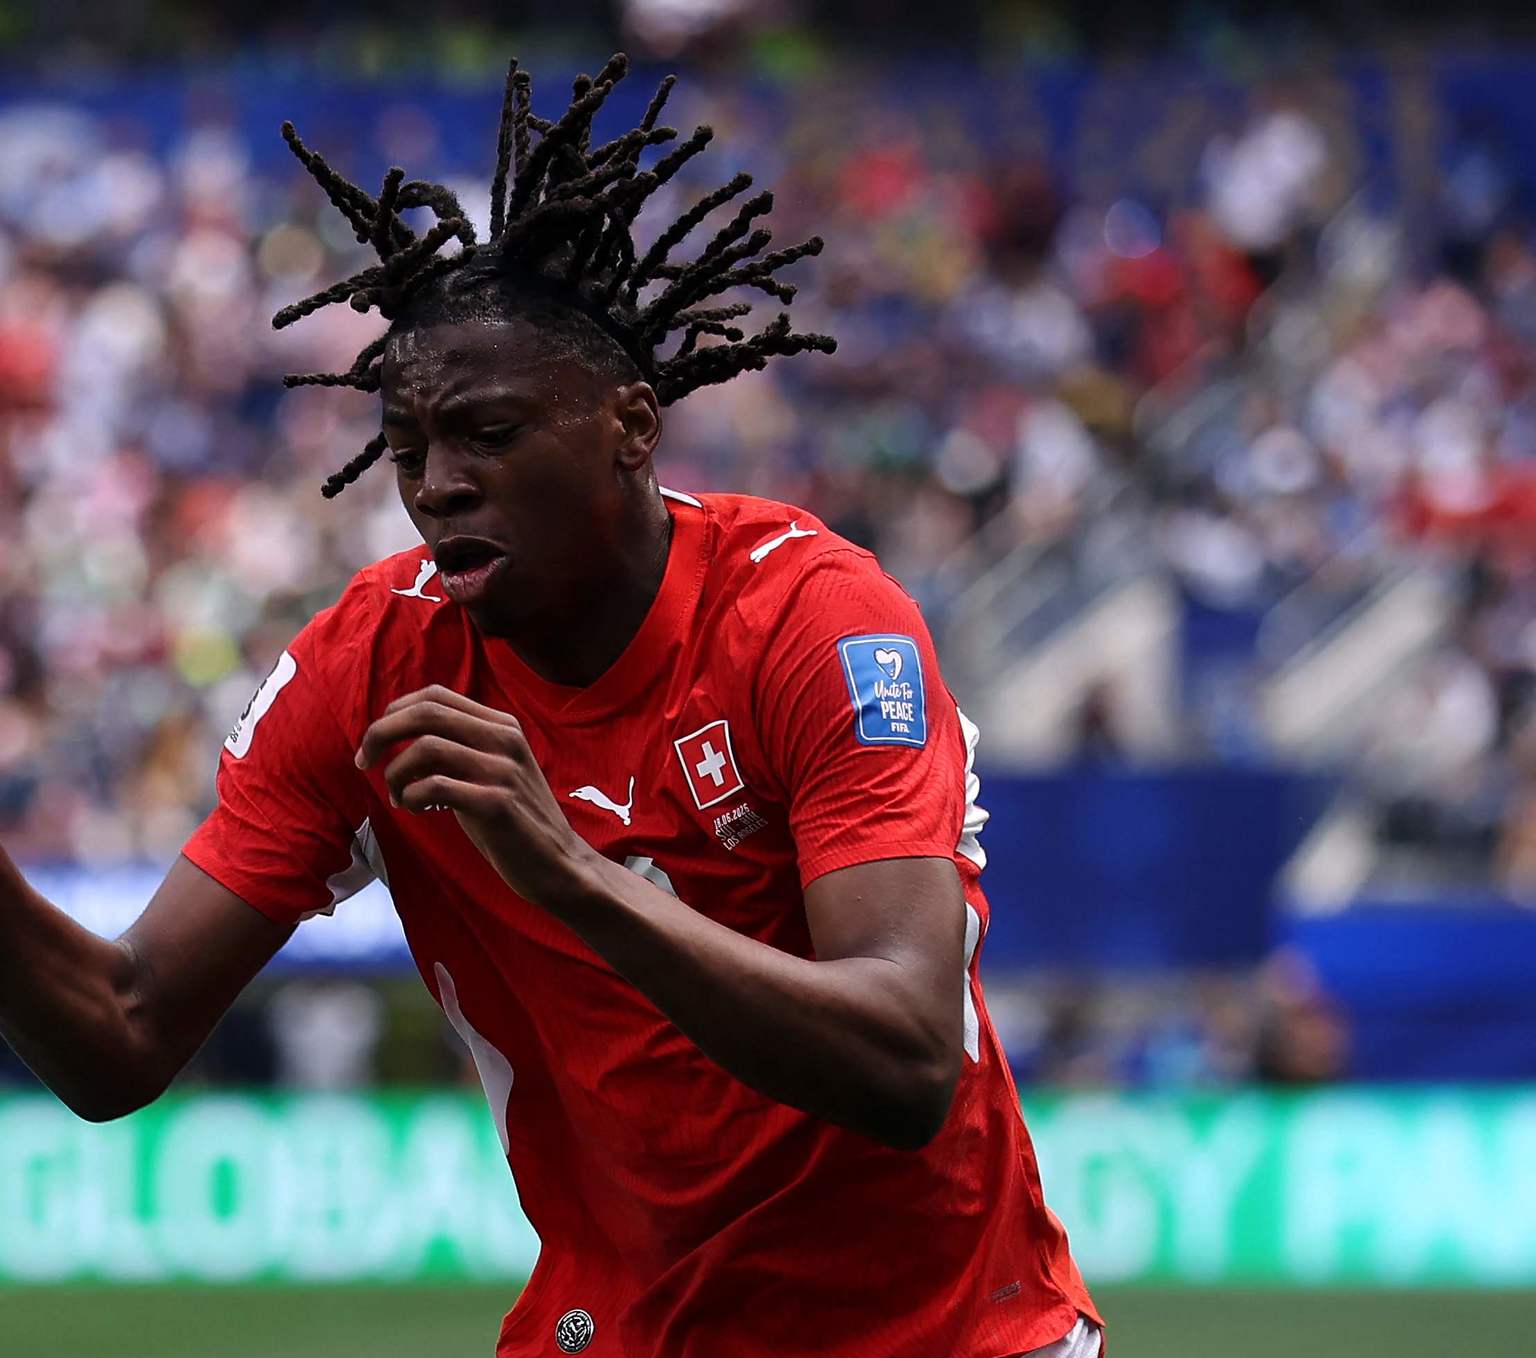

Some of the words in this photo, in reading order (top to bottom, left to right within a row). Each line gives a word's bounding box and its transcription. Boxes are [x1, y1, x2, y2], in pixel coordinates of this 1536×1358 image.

[880, 701, 914, 722] PEACE
[891, 722, 910, 733] FIFA
[723, 835, 739, 851] LOS
